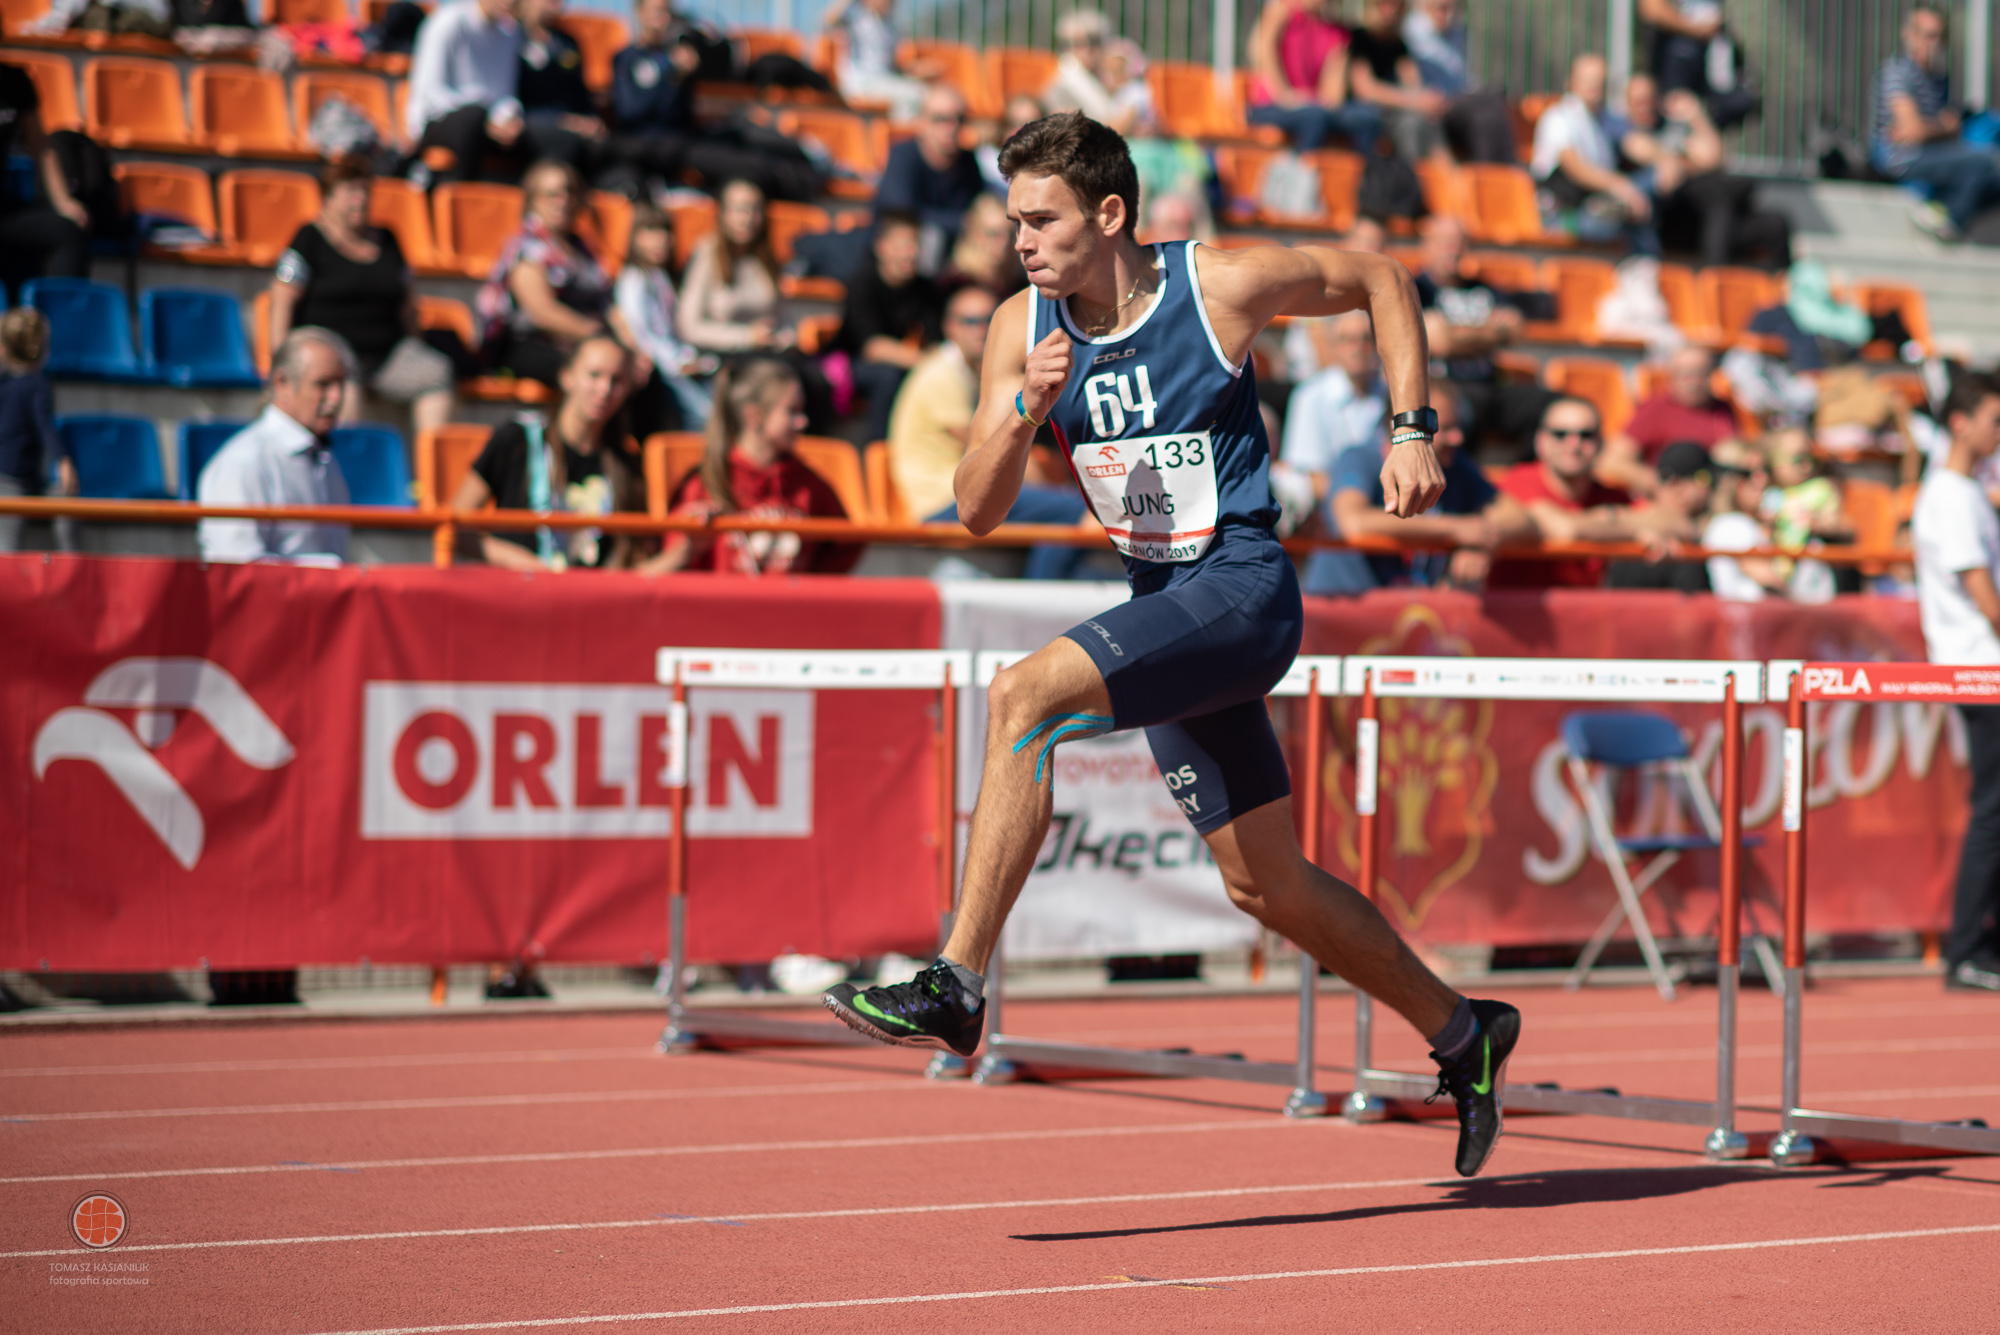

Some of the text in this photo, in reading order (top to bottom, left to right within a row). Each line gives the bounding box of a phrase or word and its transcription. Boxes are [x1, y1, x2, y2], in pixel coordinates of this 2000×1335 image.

[1093, 348, 1136, 365] COLO
[1083, 365, 1158, 438] 64
[1145, 438, 1205, 471] 133
[1088, 464, 1125, 477] ORLEN
[1121, 493, 1175, 516] JUNG
[1167, 544, 1197, 559] 2019
[1803, 667, 1872, 695] PZLA
[390, 709, 781, 813] ORLEN
[1165, 764, 1198, 791] OS
